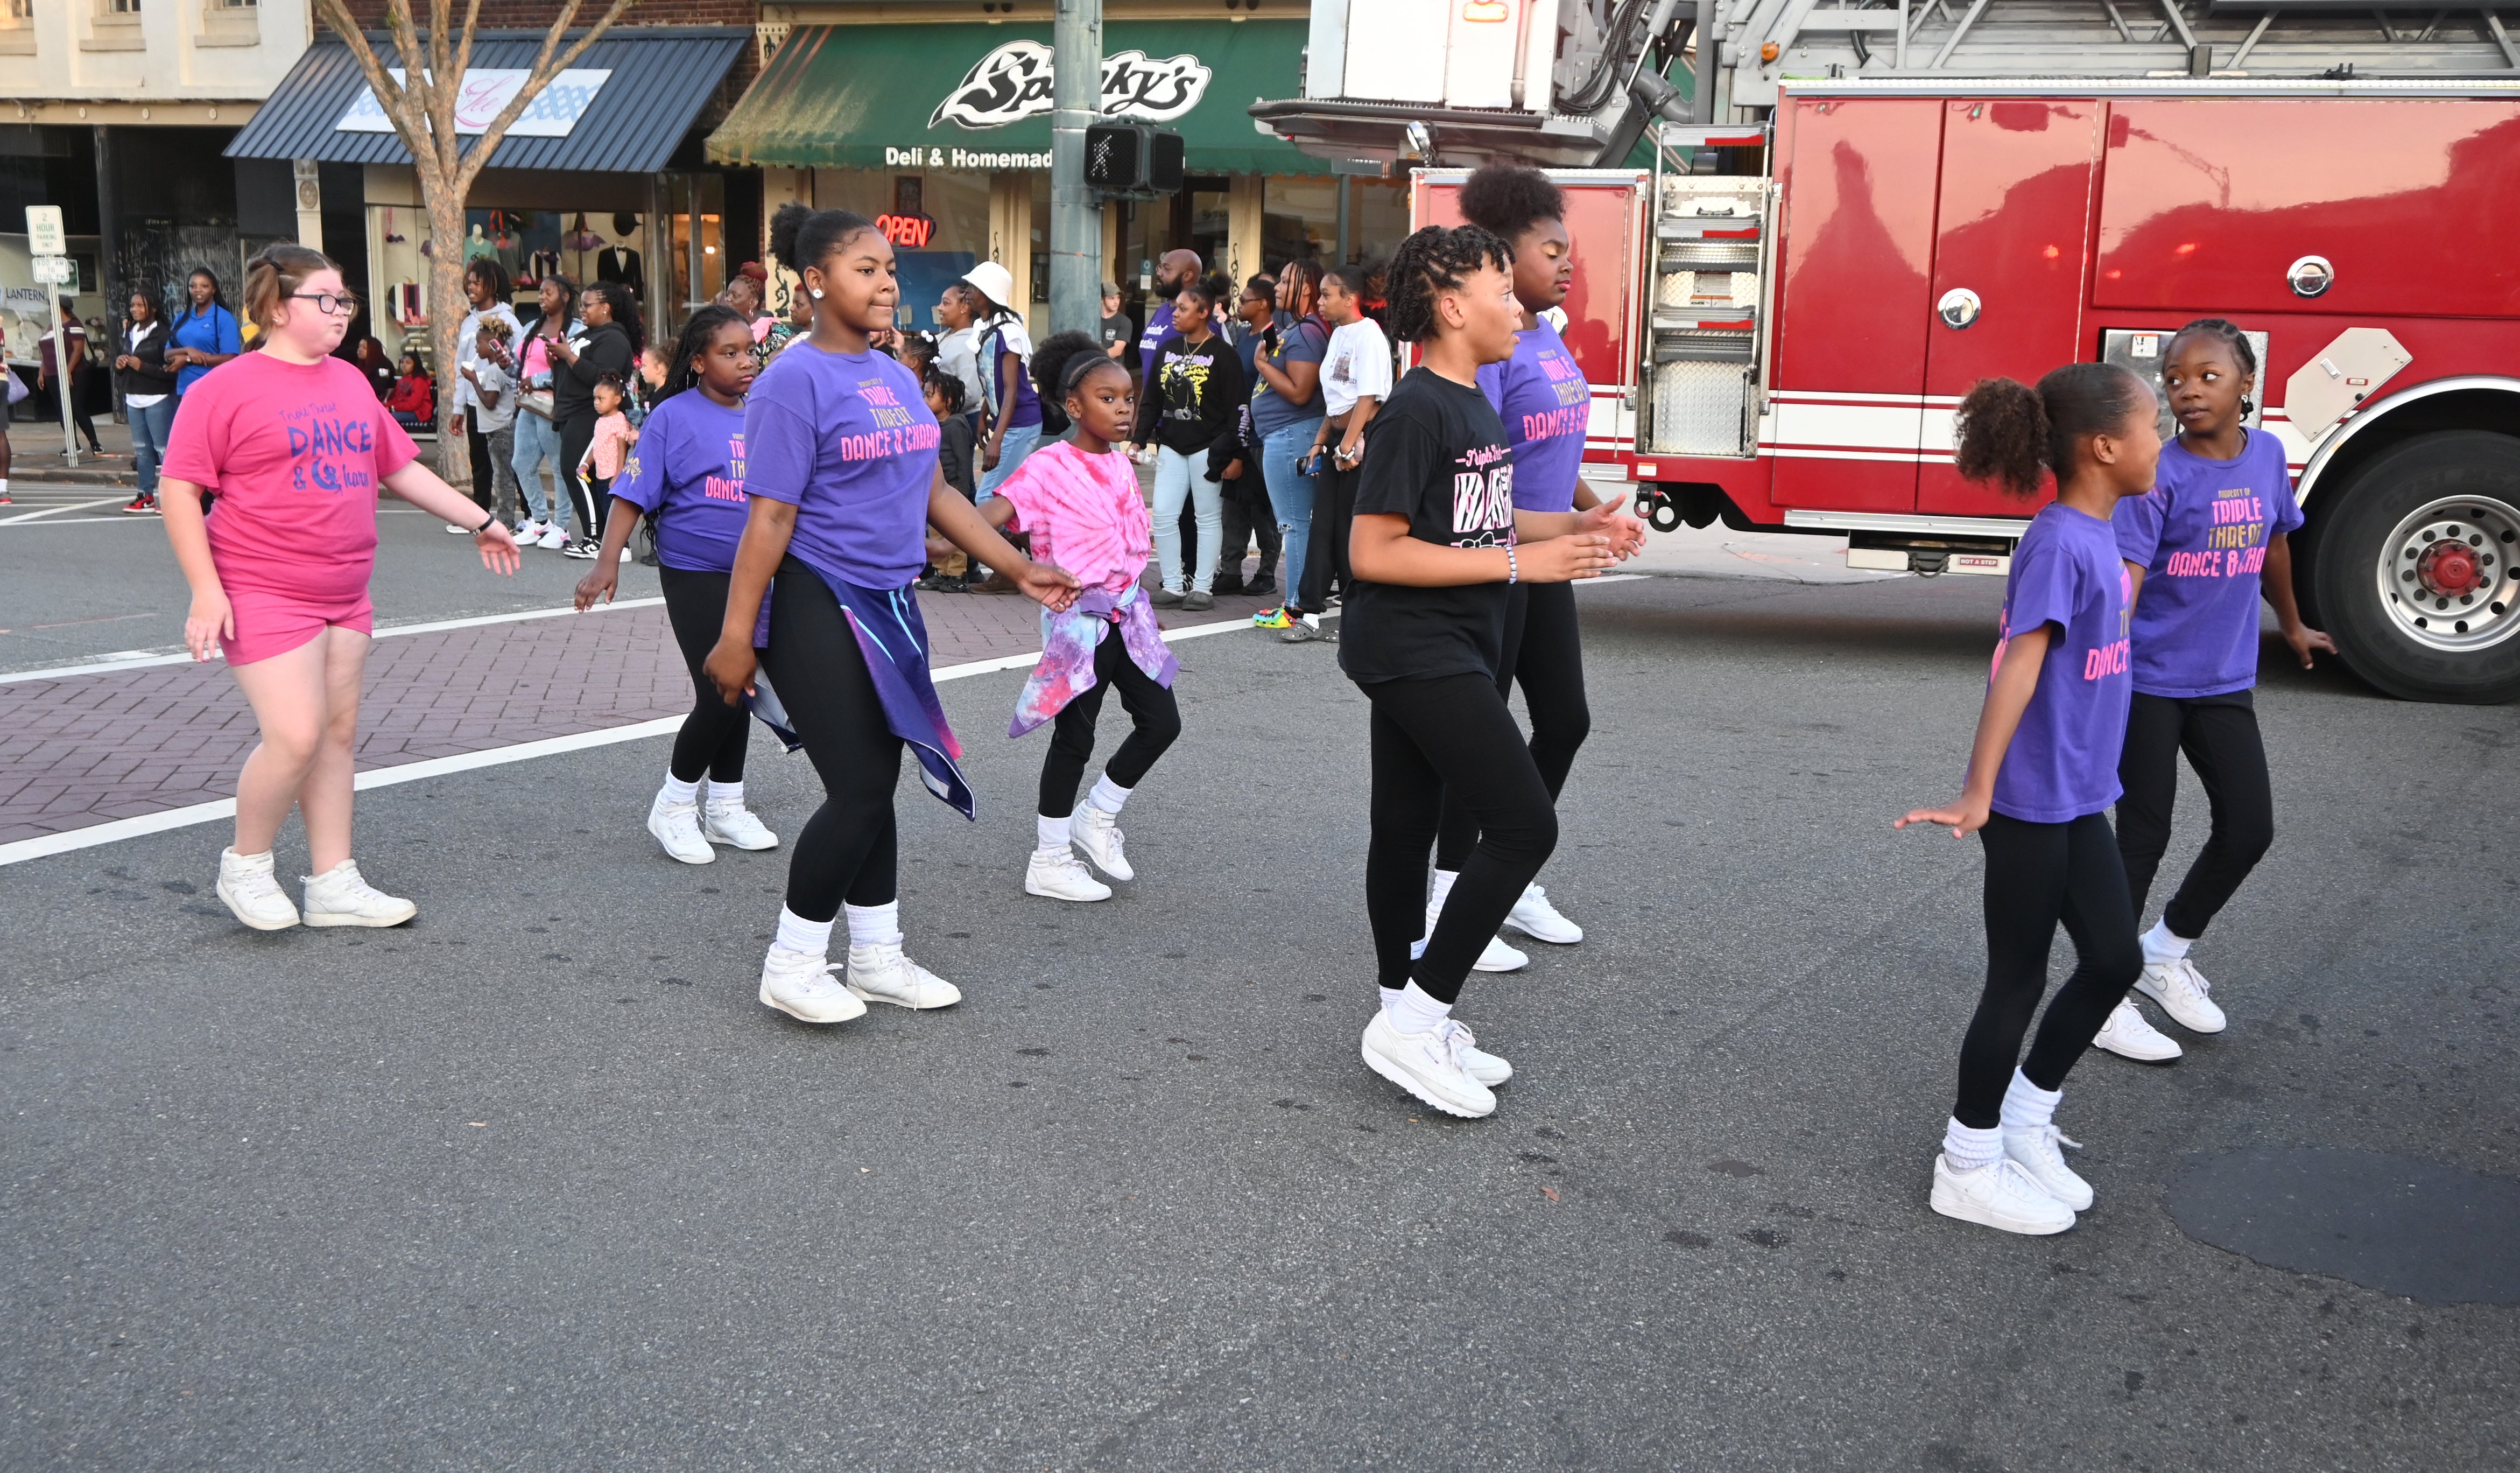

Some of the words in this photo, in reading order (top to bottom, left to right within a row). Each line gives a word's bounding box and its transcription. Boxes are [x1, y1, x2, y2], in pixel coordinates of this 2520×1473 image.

[958, 52, 1196, 115] Spaky's
[886, 147, 923, 166] Deli
[929, 148, 944, 166] &
[36, 223, 55, 232] HOUR
[42, 213, 48, 221] 2
[875, 214, 930, 247] OPEN
[6, 287, 45, 301] LANTERN
[857, 385, 900, 406] TRIPLE
[1551, 378, 1587, 406] THREAT
[869, 406, 915, 429] THREAT
[1523, 407, 1568, 440] DANCE
[287, 418, 371, 458] DANCE
[728, 440, 745, 459] TR
[841, 430, 891, 461] DANCE
[894, 429, 904, 454] &
[293, 466, 307, 490] &
[706, 475, 747, 502] DANCE
[2212, 497, 2263, 524] TRIPLE
[2208, 523, 2264, 549] THREAT
[2167, 551, 2221, 577] DANCE
[2226, 550, 2239, 577] &
